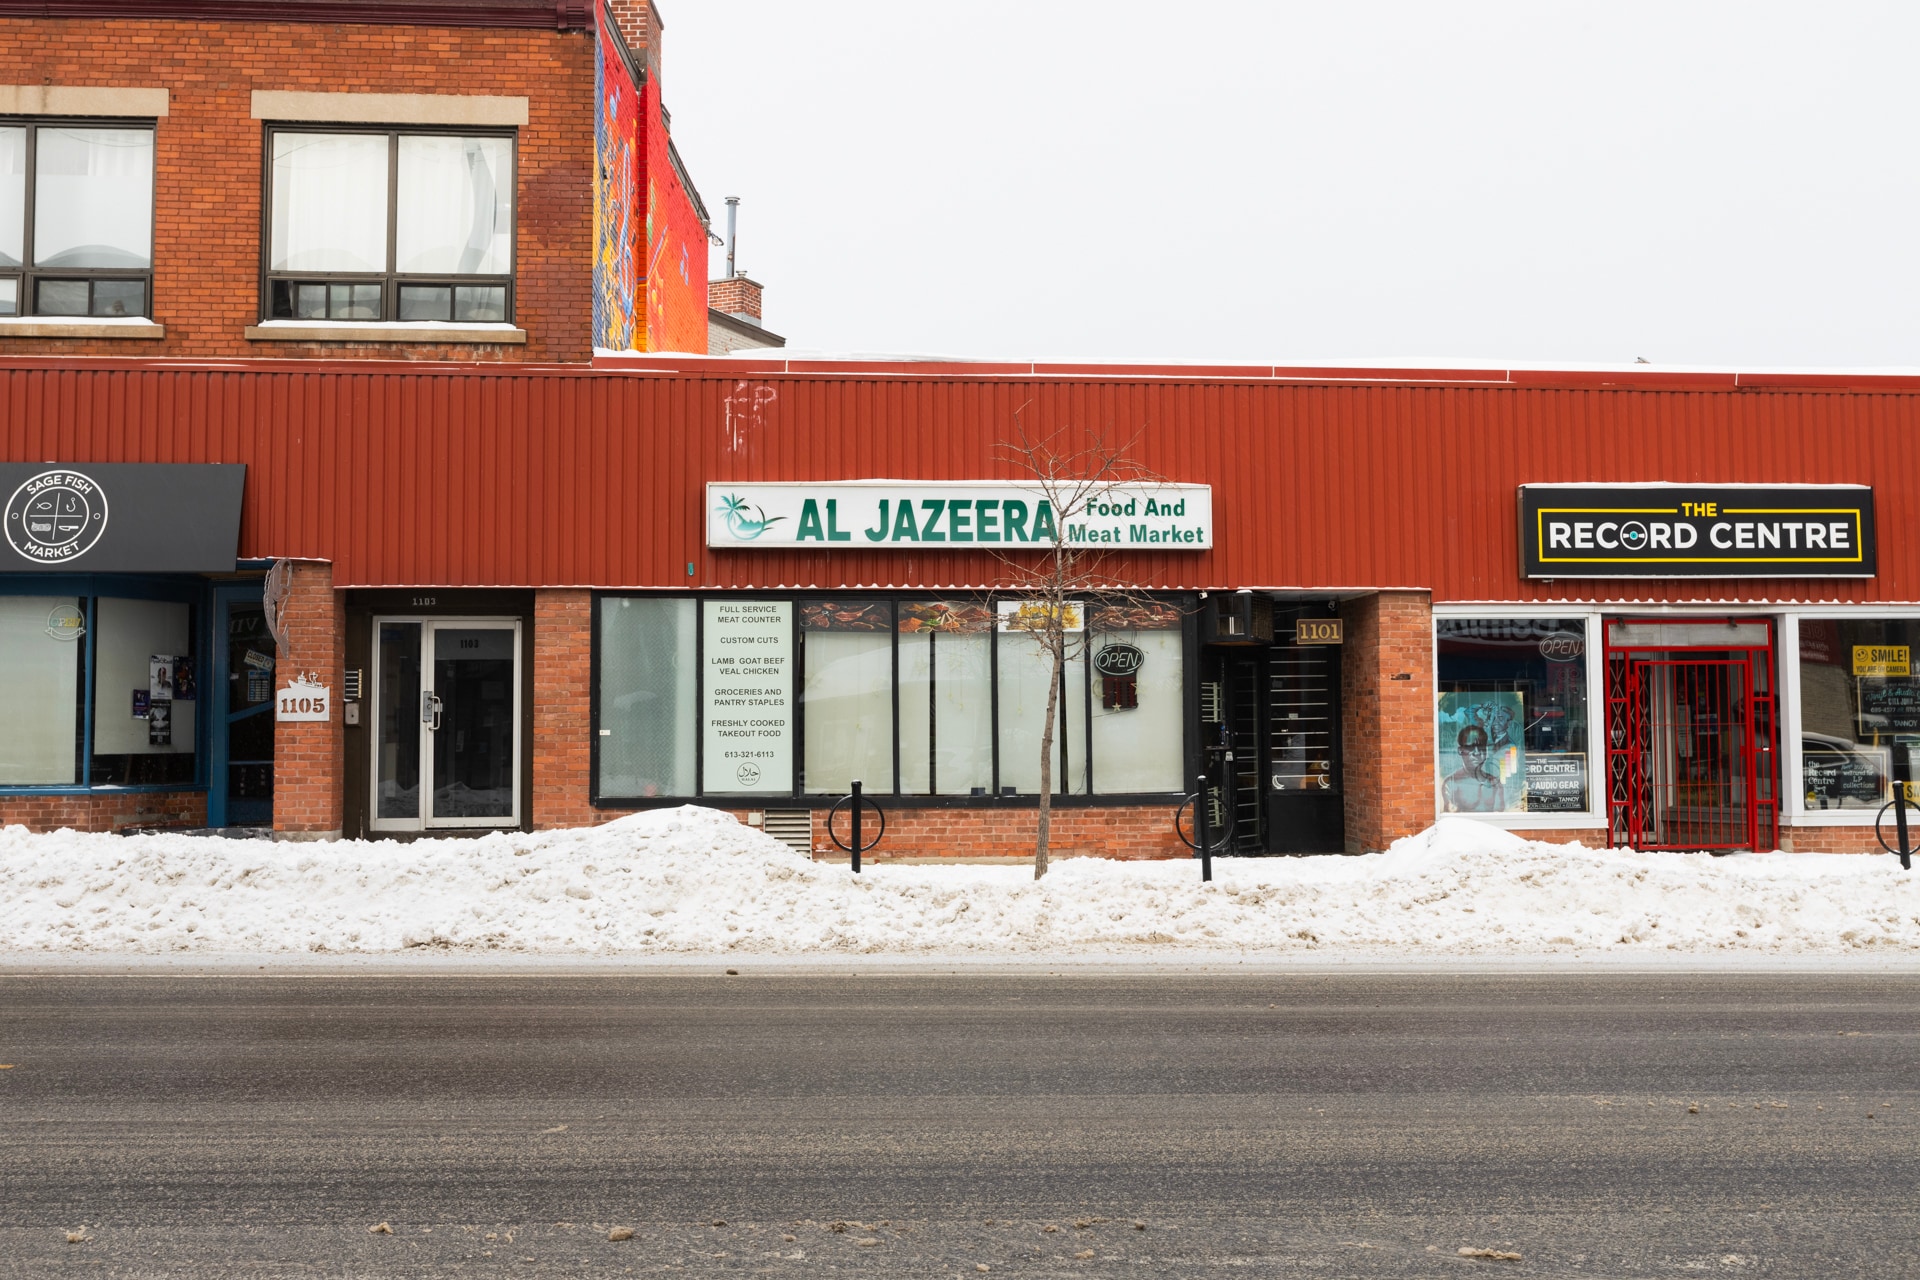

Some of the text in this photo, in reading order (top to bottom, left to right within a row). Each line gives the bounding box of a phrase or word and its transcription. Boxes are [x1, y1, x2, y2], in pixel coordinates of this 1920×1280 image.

[27, 475, 93, 495] SAGE FISH
[1086, 498, 1186, 517] Food And
[1681, 503, 1717, 517] THE
[796, 498, 1060, 542] AL JAZEERA
[1068, 523, 1204, 545] Meat Market
[1549, 520, 1850, 550] RECORD CENTRE
[23, 541, 80, 558] MARKET
[412, 597, 437, 606] 1103
[719, 605, 777, 613] FULL SERVICE
[50, 617, 81, 627] OPEN
[1299, 623, 1340, 640] 1101
[460, 639, 479, 648] 1103
[720, 636, 779, 644] CUSTOM CUTS
[1542, 639, 1580, 655] OPEN
[1098, 652, 1140, 668] OPEN
[1871, 649, 1907, 662] SMILE!
[711, 657, 785, 665] LAMB GOAT BEEF
[719, 667, 779, 675] VEAL CHICKEN
[1856, 665, 1866, 673] YOU
[1867, 665, 1877, 673] ARE
[1886, 665, 1907, 673] CAMERA
[714, 688, 782, 696] GROCERIES AND
[281, 698, 325, 713] 1105
[714, 698, 785, 706] PANTRY STAPLES
[711, 719, 786, 727] FRESHLY COOKED
[1893, 719, 1918, 727] TANNOY
[1543, 764, 1576, 773] CENTRE
[1535, 781, 1558, 790] AUDIO
[1559, 780, 1580, 789] GEAR
[1808, 776, 1835, 785] Centre
